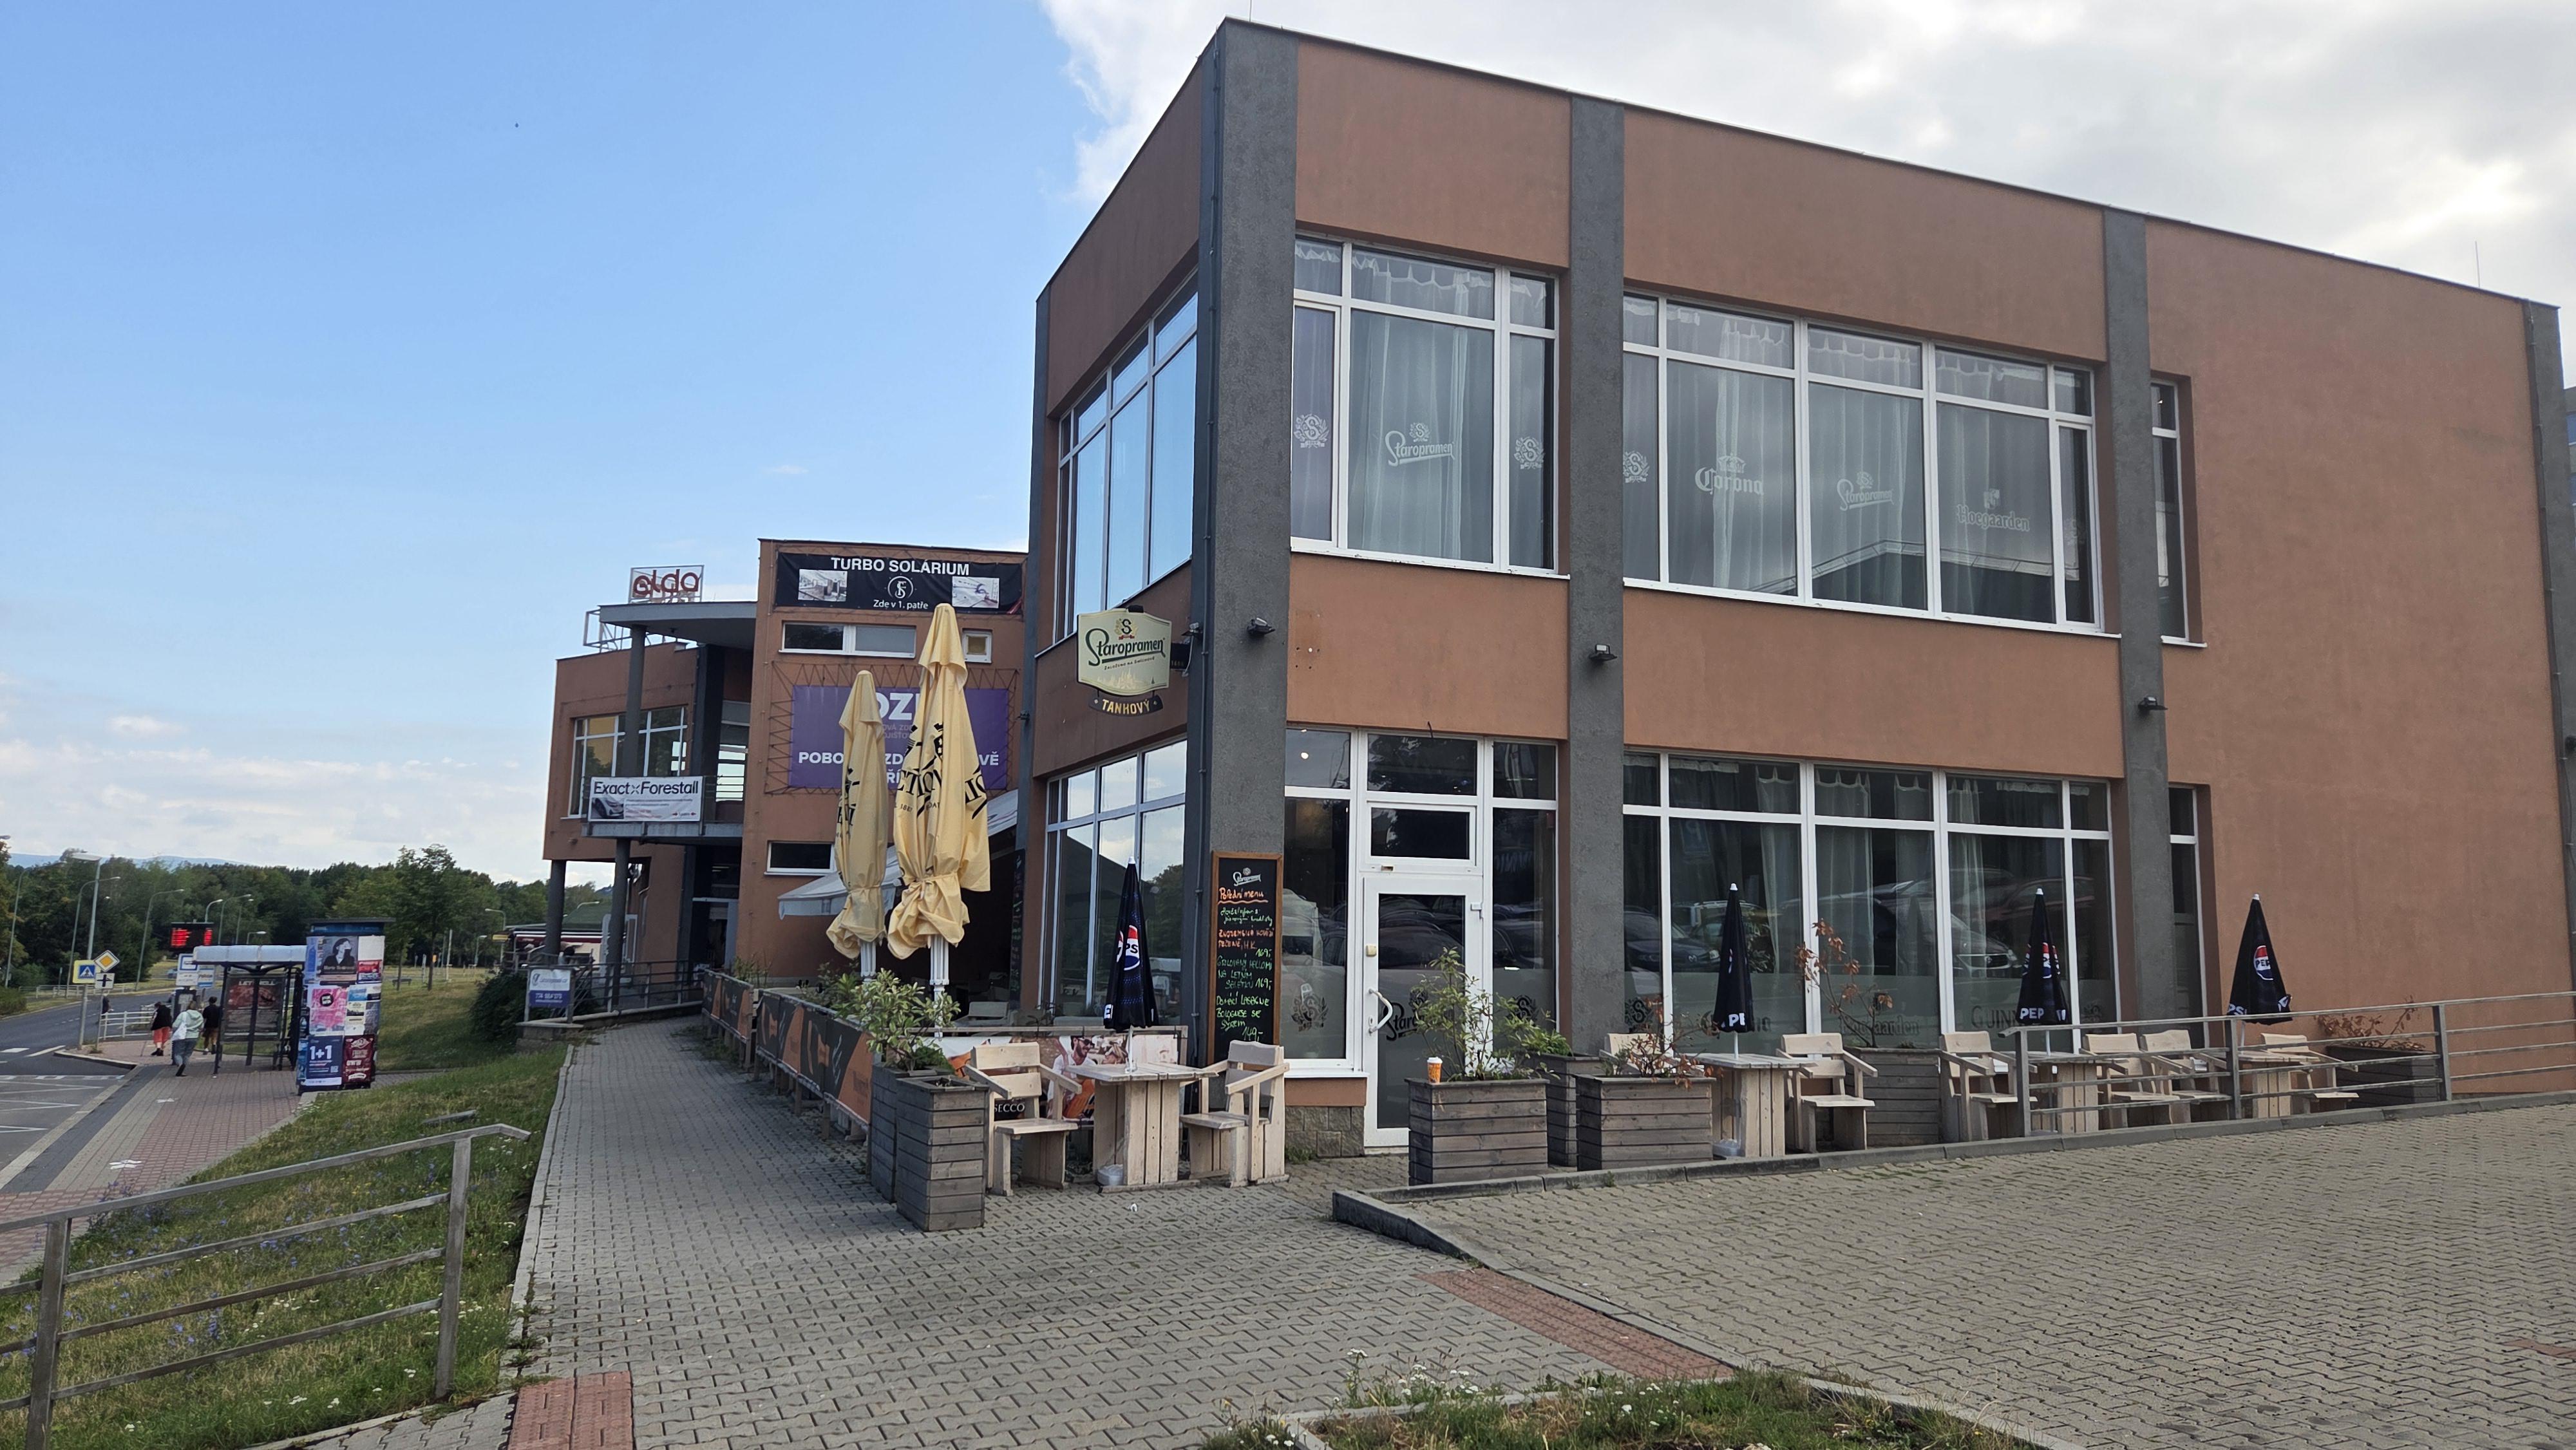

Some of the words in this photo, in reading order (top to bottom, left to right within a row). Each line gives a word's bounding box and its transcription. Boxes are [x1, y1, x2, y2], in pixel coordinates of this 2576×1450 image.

[1385, 430, 1455, 467] Staropramen
[1695, 467, 1765, 494] Corona
[1956, 504, 2030, 532] Hoegaarden
[831, 557, 885, 572] TURBO
[889, 558, 969, 576] SOLÁRIUM
[873, 600, 889, 608] Zde
[907, 600, 929, 610] patře
[1085, 628, 1166, 666] Staropramen
[1102, 698, 1150, 715] TANKOVÝ
[799, 751, 844, 764] POBO
[979, 751, 999, 766] VĚ
[594, 781, 630, 795] Exact
[640, 780, 699, 795] Forestall
[2020, 1008, 2045, 1020] PEP
[310, 1044, 332, 1060] 1+1
